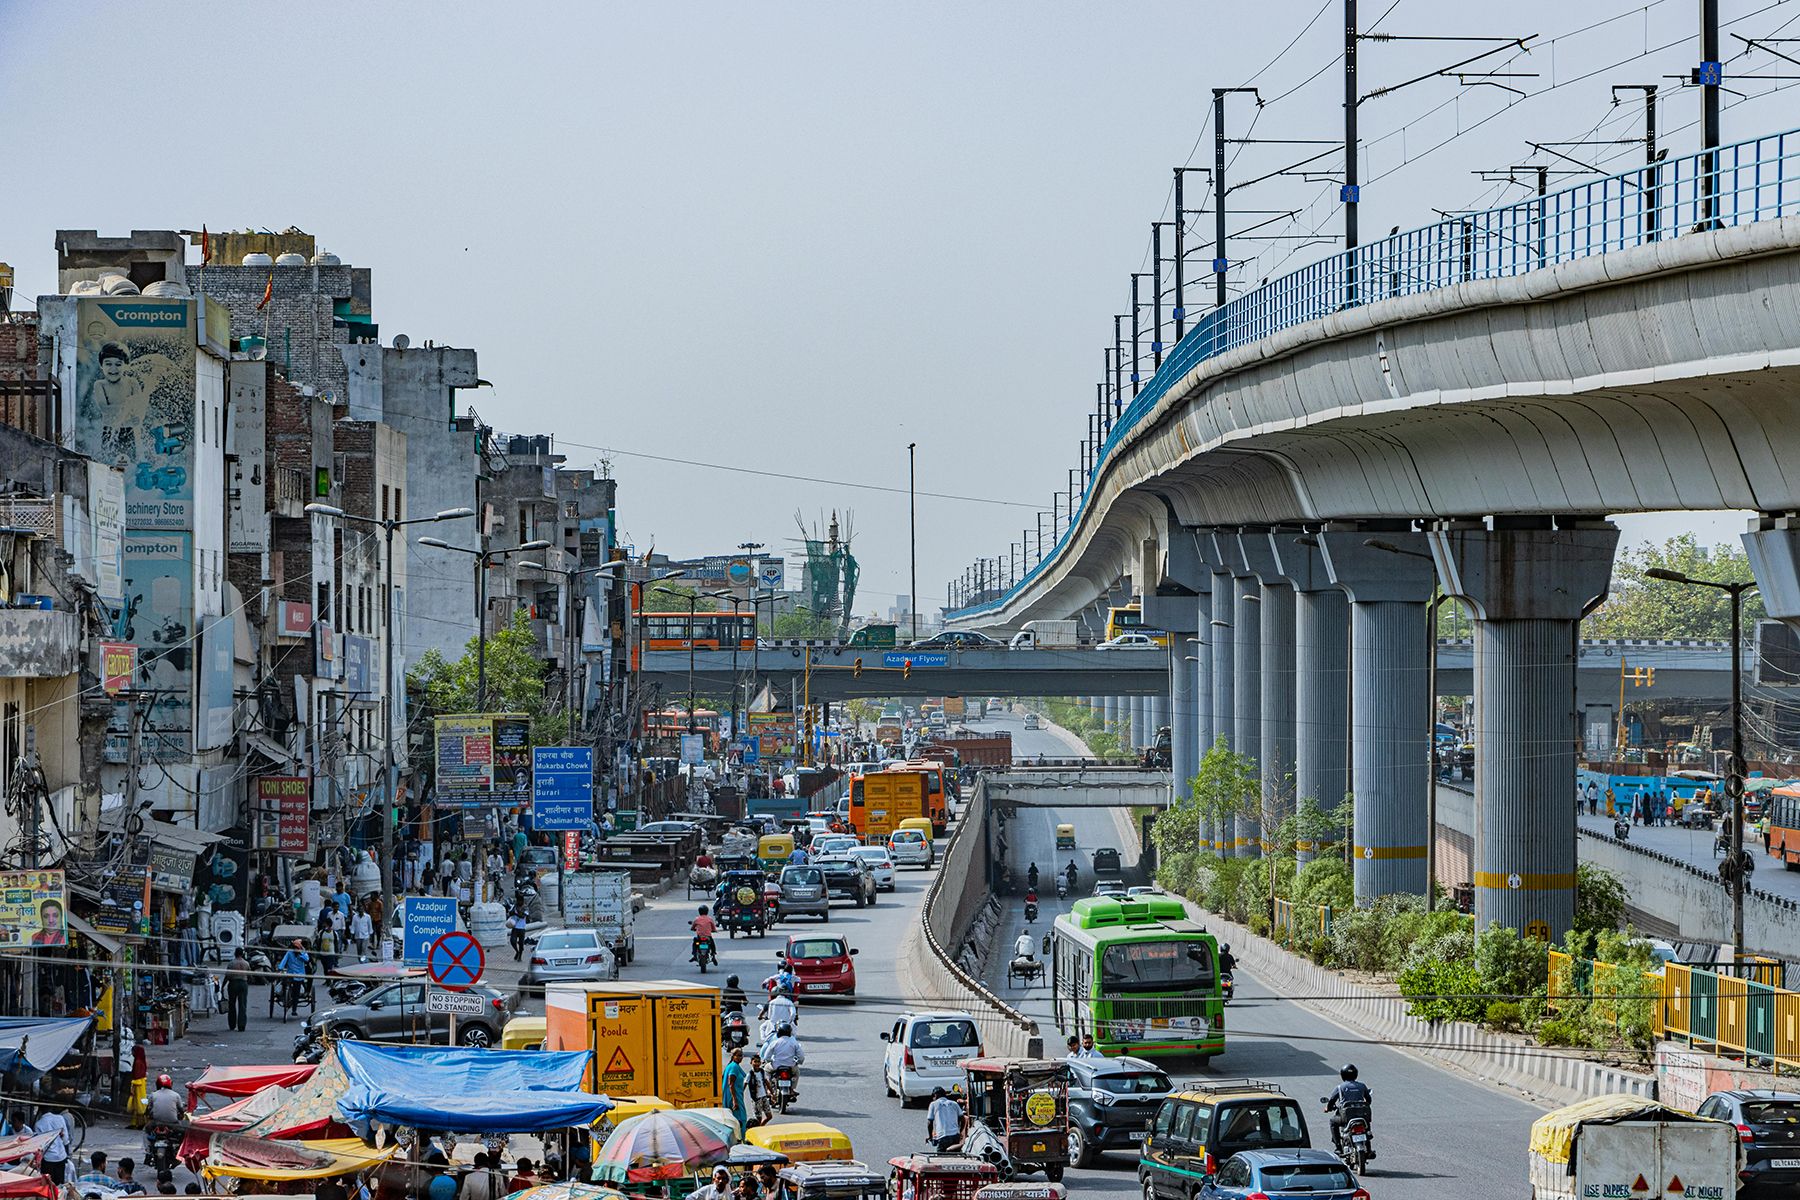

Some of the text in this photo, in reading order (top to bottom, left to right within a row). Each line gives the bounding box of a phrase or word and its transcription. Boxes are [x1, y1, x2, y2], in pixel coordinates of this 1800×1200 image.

[1708, 63, 1714, 73] 6
[115, 309, 182, 323] Crompton
[125, 502, 184, 517] achinery Store
[919, 655, 947, 663] Flyover
[560, 750, 574, 759] चौक
[261, 781, 305, 795] TONI SHOES
[545, 805, 571, 814] शालीमार
[574, 817, 591, 826] Bagh
[415, 901, 447, 912] Azadpur
[408, 913, 453, 923] Commercial
[596, 914, 616, 922] PLEASE
[413, 925, 447, 936] Complex
[444, 996, 481, 1005] STOPPING
[444, 1004, 480, 1012] STANDING
[1584, 1184, 1723, 1198] USE DIPPER AT NIGHT
